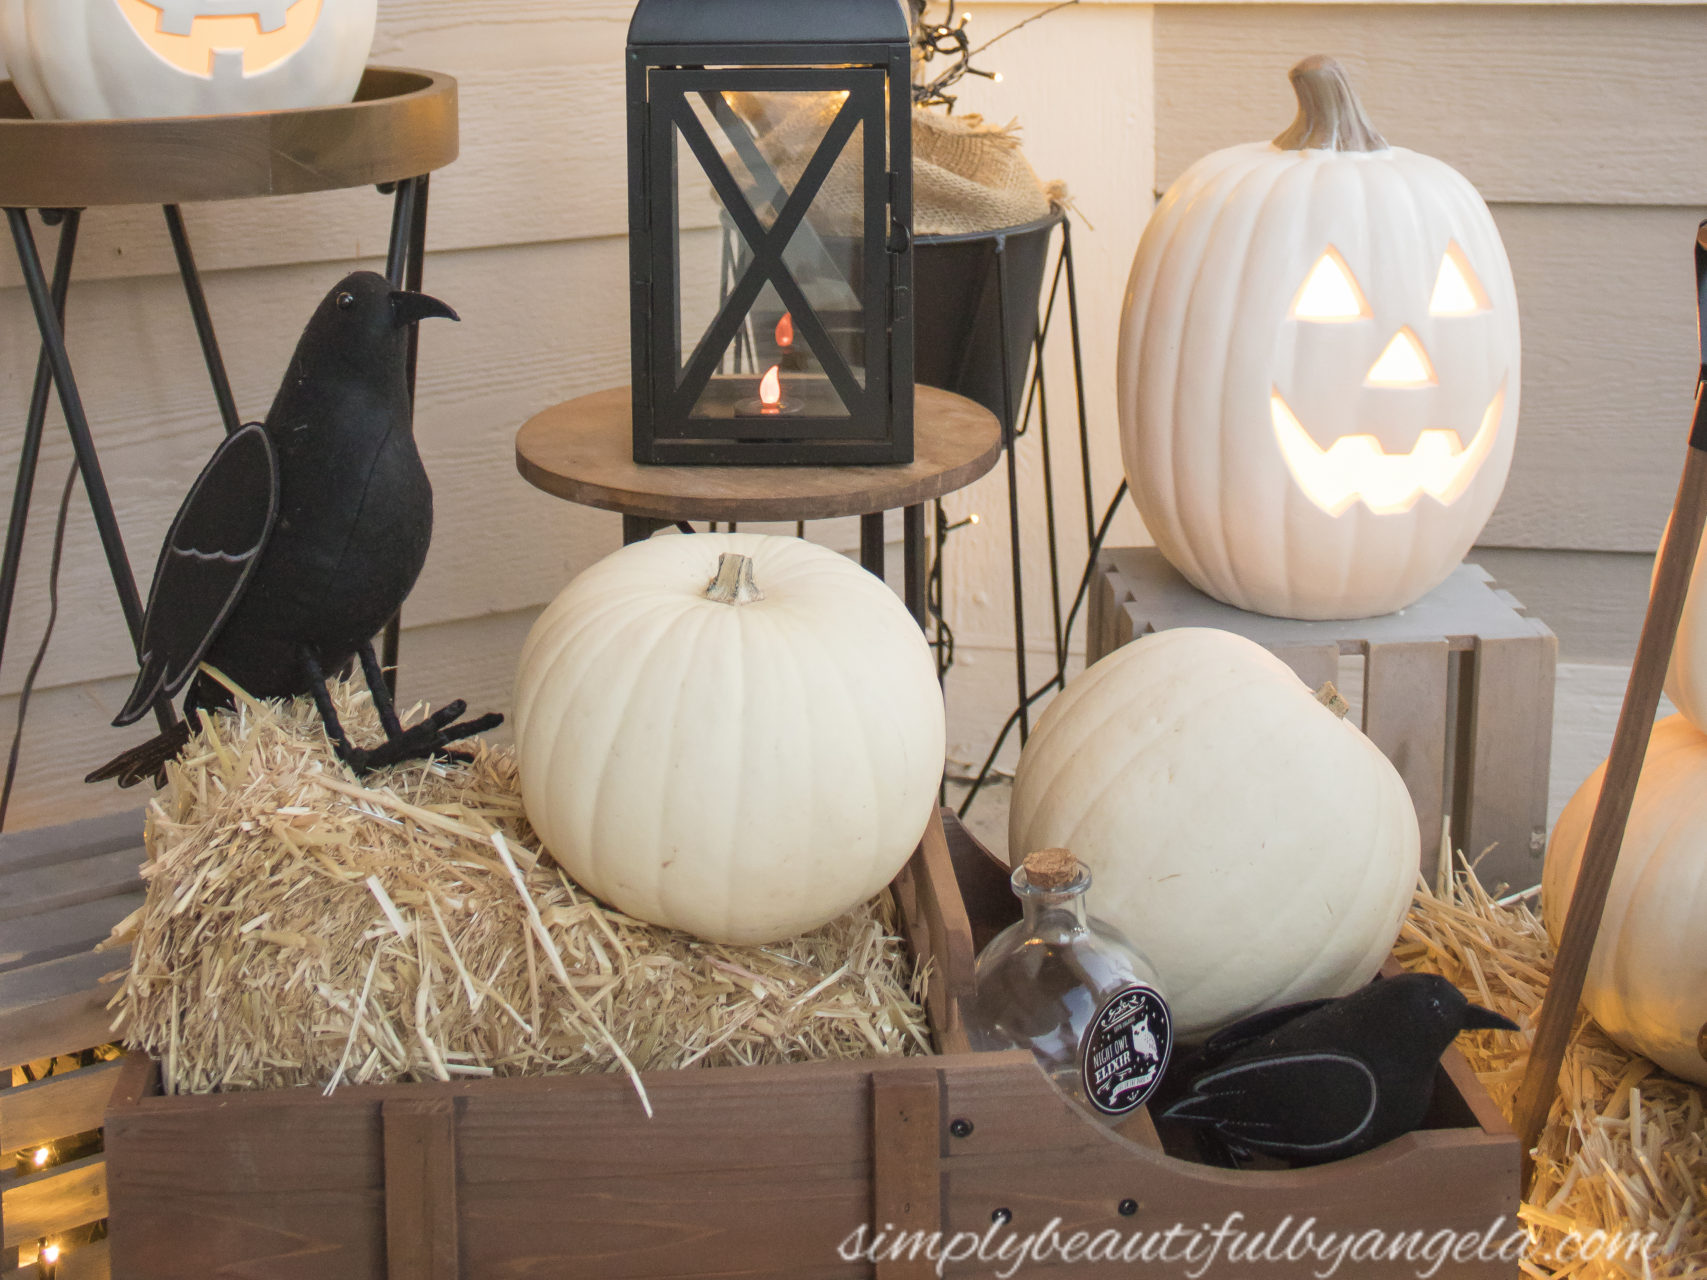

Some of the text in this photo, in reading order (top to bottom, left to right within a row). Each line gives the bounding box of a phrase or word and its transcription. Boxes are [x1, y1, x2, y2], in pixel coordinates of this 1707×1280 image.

[1093, 1035, 1129, 1069] NIGHT OWL
[1094, 1050, 1131, 1085] ELIXIR
